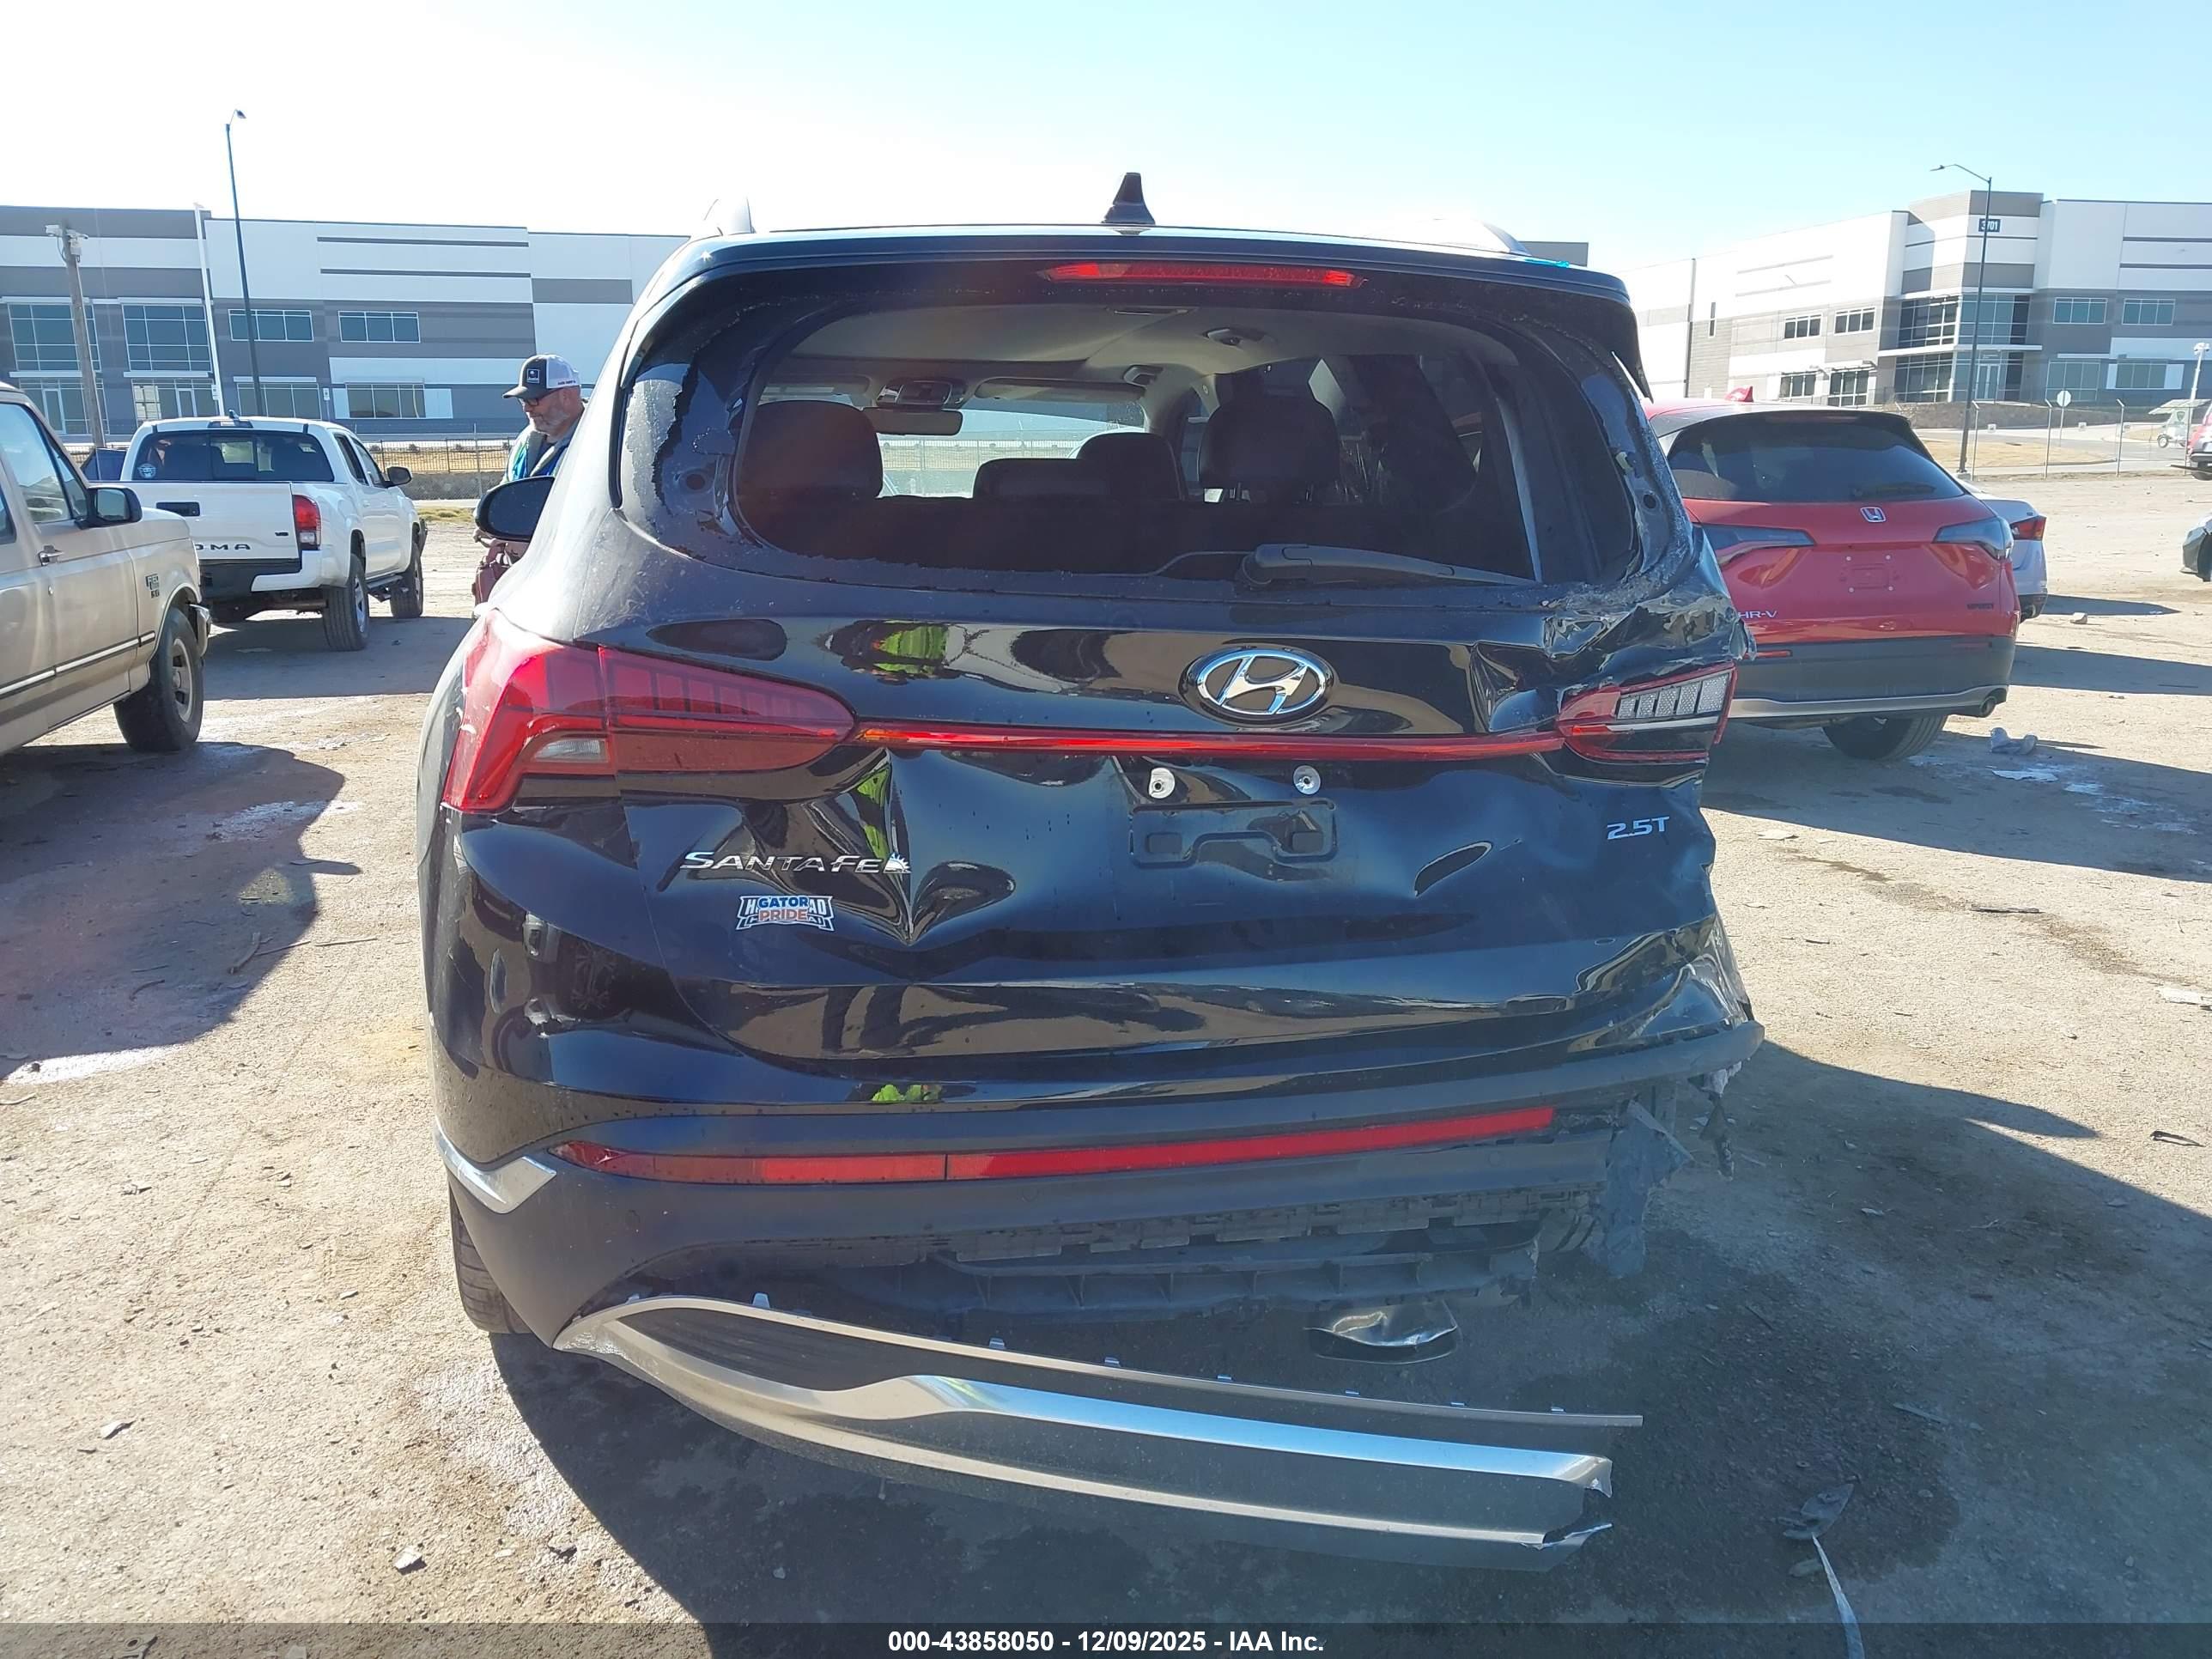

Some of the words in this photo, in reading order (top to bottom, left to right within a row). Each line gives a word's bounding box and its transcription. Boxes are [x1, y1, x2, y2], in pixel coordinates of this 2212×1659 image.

[1737, 611, 1778, 619] HR-V
[1607, 816, 1670, 840] 2.5T
[679, 851, 825, 872] SANTA
[830, 855, 883, 873] FE
[757, 896, 810, 908] GATOR
[758, 908, 808, 921] PRIDE
